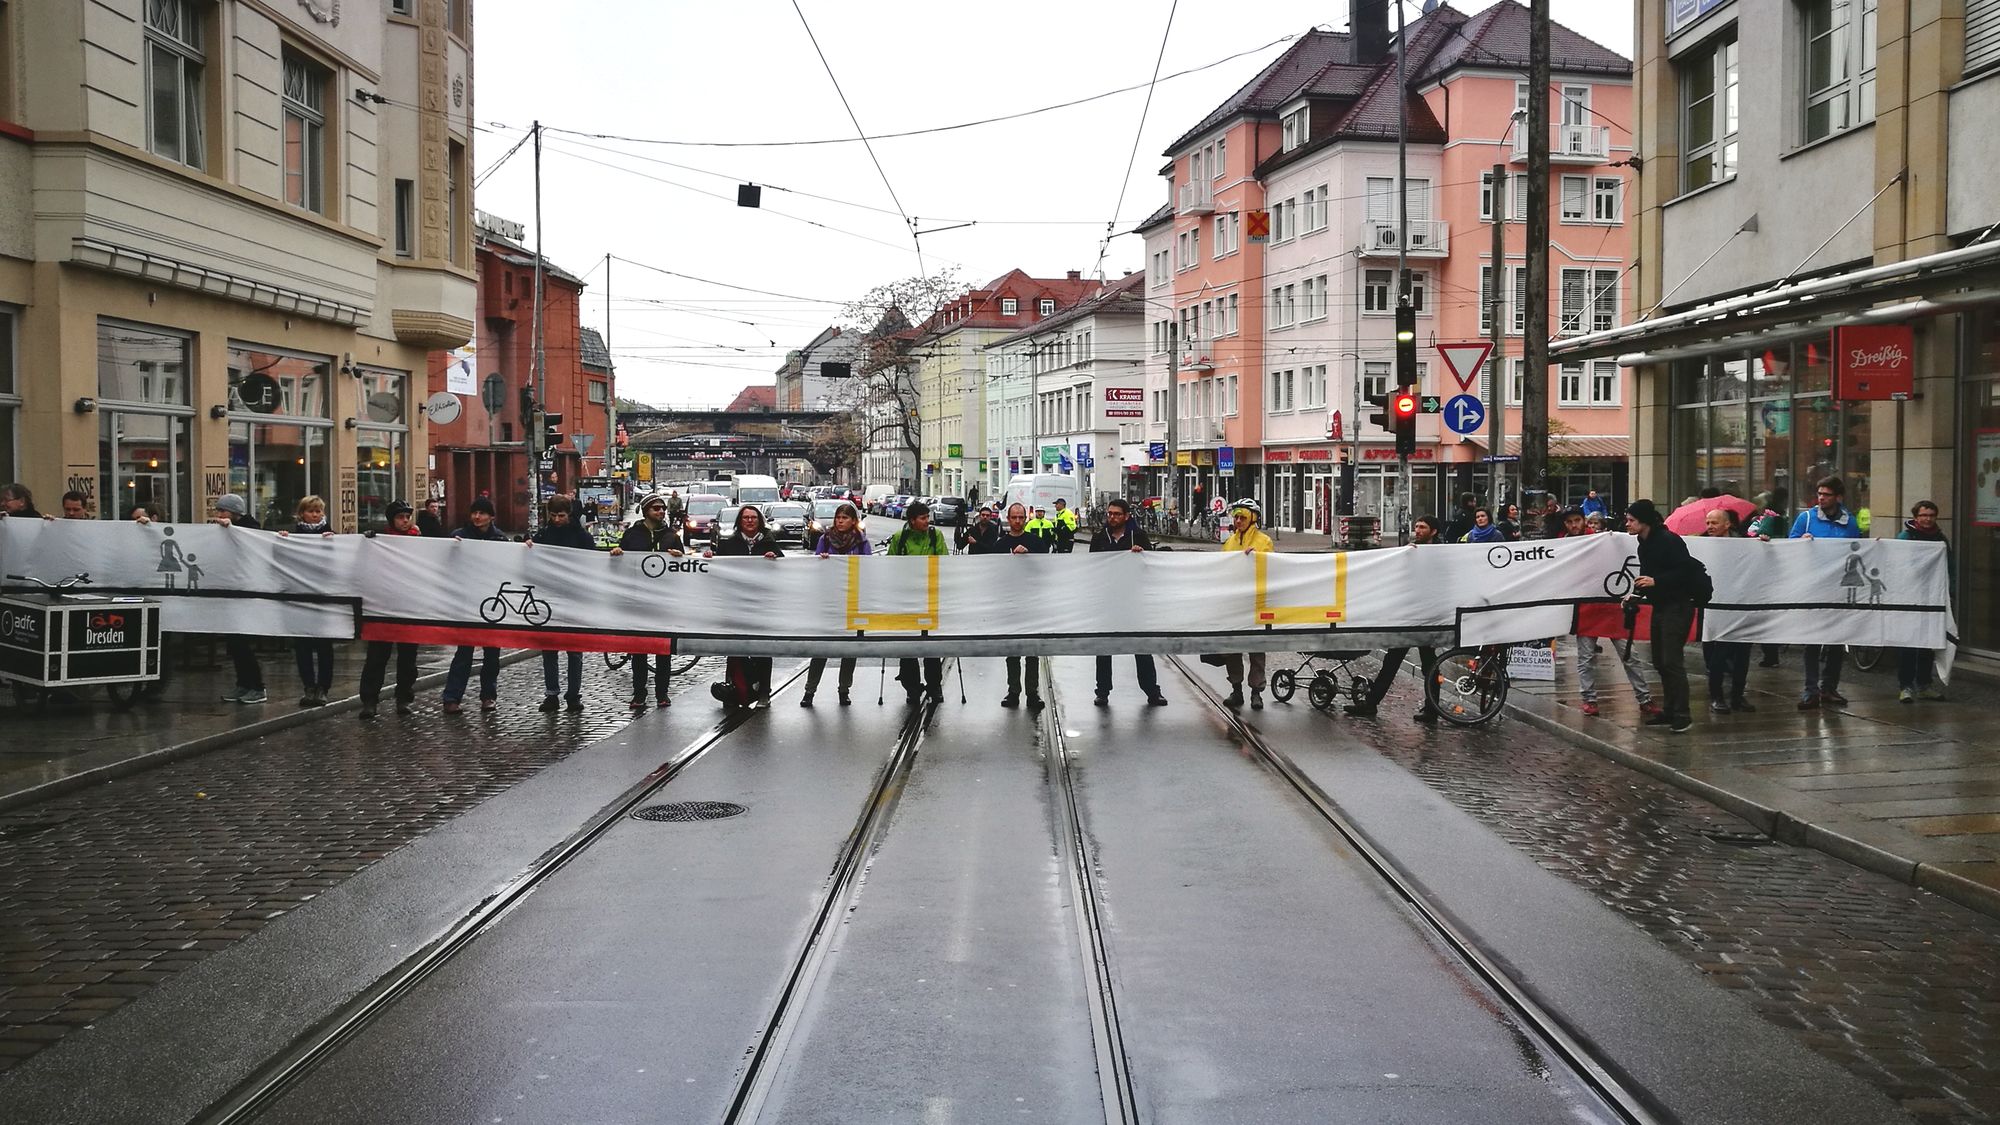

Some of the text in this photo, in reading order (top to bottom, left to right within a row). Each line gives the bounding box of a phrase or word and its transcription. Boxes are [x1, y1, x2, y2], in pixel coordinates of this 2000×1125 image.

[1849, 344, 1908, 368] Dreißig
[1364, 449, 1433, 459] APOTEKE
[1086, 459, 1092, 467] P
[206, 473, 226, 496] NACH
[342, 490, 355, 514] EIER
[1514, 546, 1555, 561] adfc
[668, 559, 709, 573] adfc
[14, 614, 36, 631] adfc
[86, 628, 124, 645] Dresden
